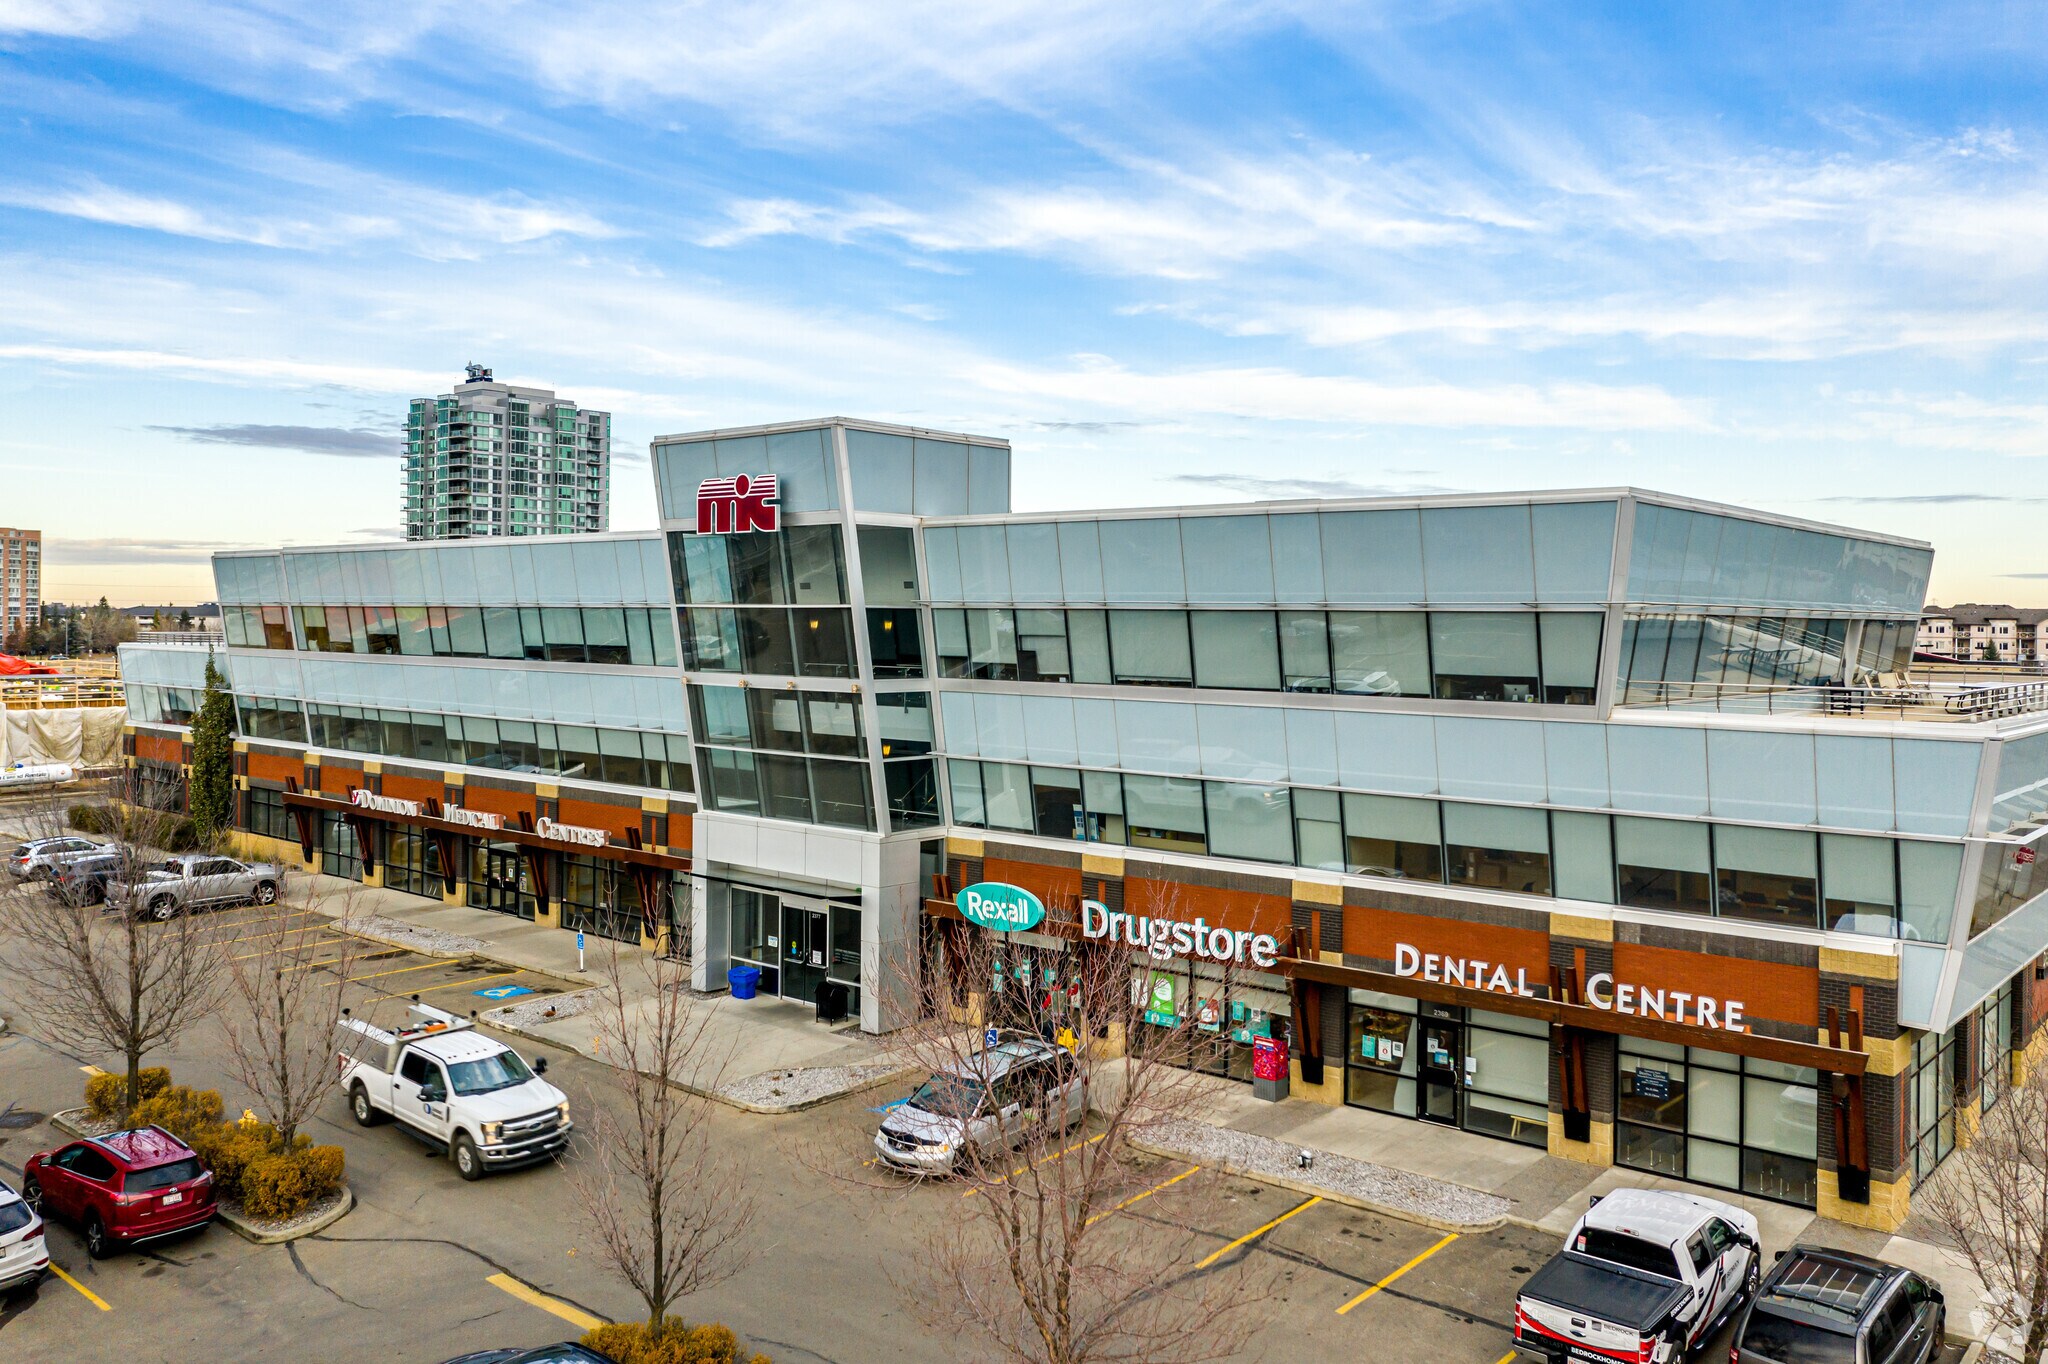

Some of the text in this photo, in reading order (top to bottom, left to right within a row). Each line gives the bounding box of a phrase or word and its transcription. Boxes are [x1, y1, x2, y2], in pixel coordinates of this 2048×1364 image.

[361, 789, 610, 848] DOMINION MEDICAL CENTRES
[968, 890, 1030, 924] Rexall
[1082, 899, 1278, 967] Drugstore
[1395, 942, 1746, 1033] DENTAL CENTRE
